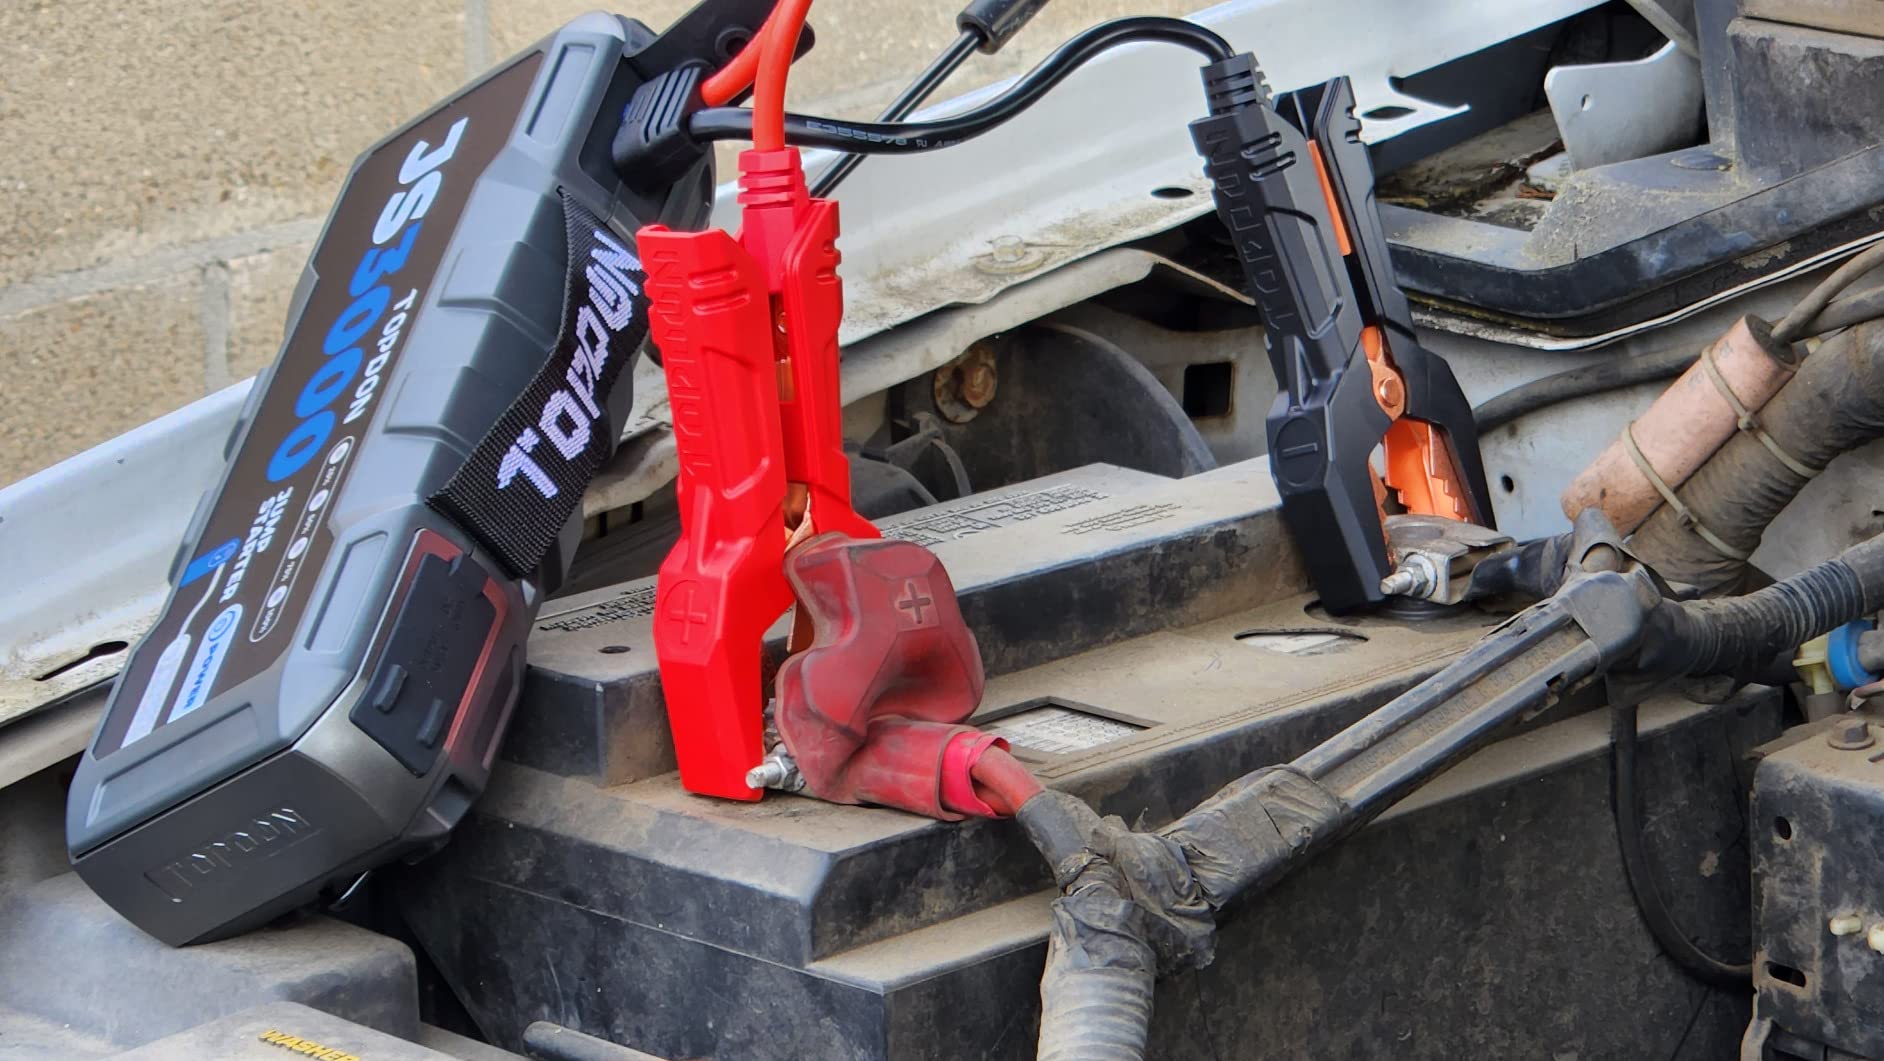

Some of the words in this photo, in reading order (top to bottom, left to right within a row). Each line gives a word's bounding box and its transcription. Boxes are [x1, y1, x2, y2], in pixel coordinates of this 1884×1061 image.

[1205, 130, 1294, 330] TOPDON
[267, 117, 468, 482] JS3000
[343, 288, 418, 425] TOPDON
[497, 229, 643, 499] TOPDON
[652, 250, 712, 476] TOPDON
[219, 496, 276, 604] STARTER
[256, 486, 294, 553] JUMP
[183, 642, 220, 710] POWER
[161, 807, 311, 888] TOPDON
